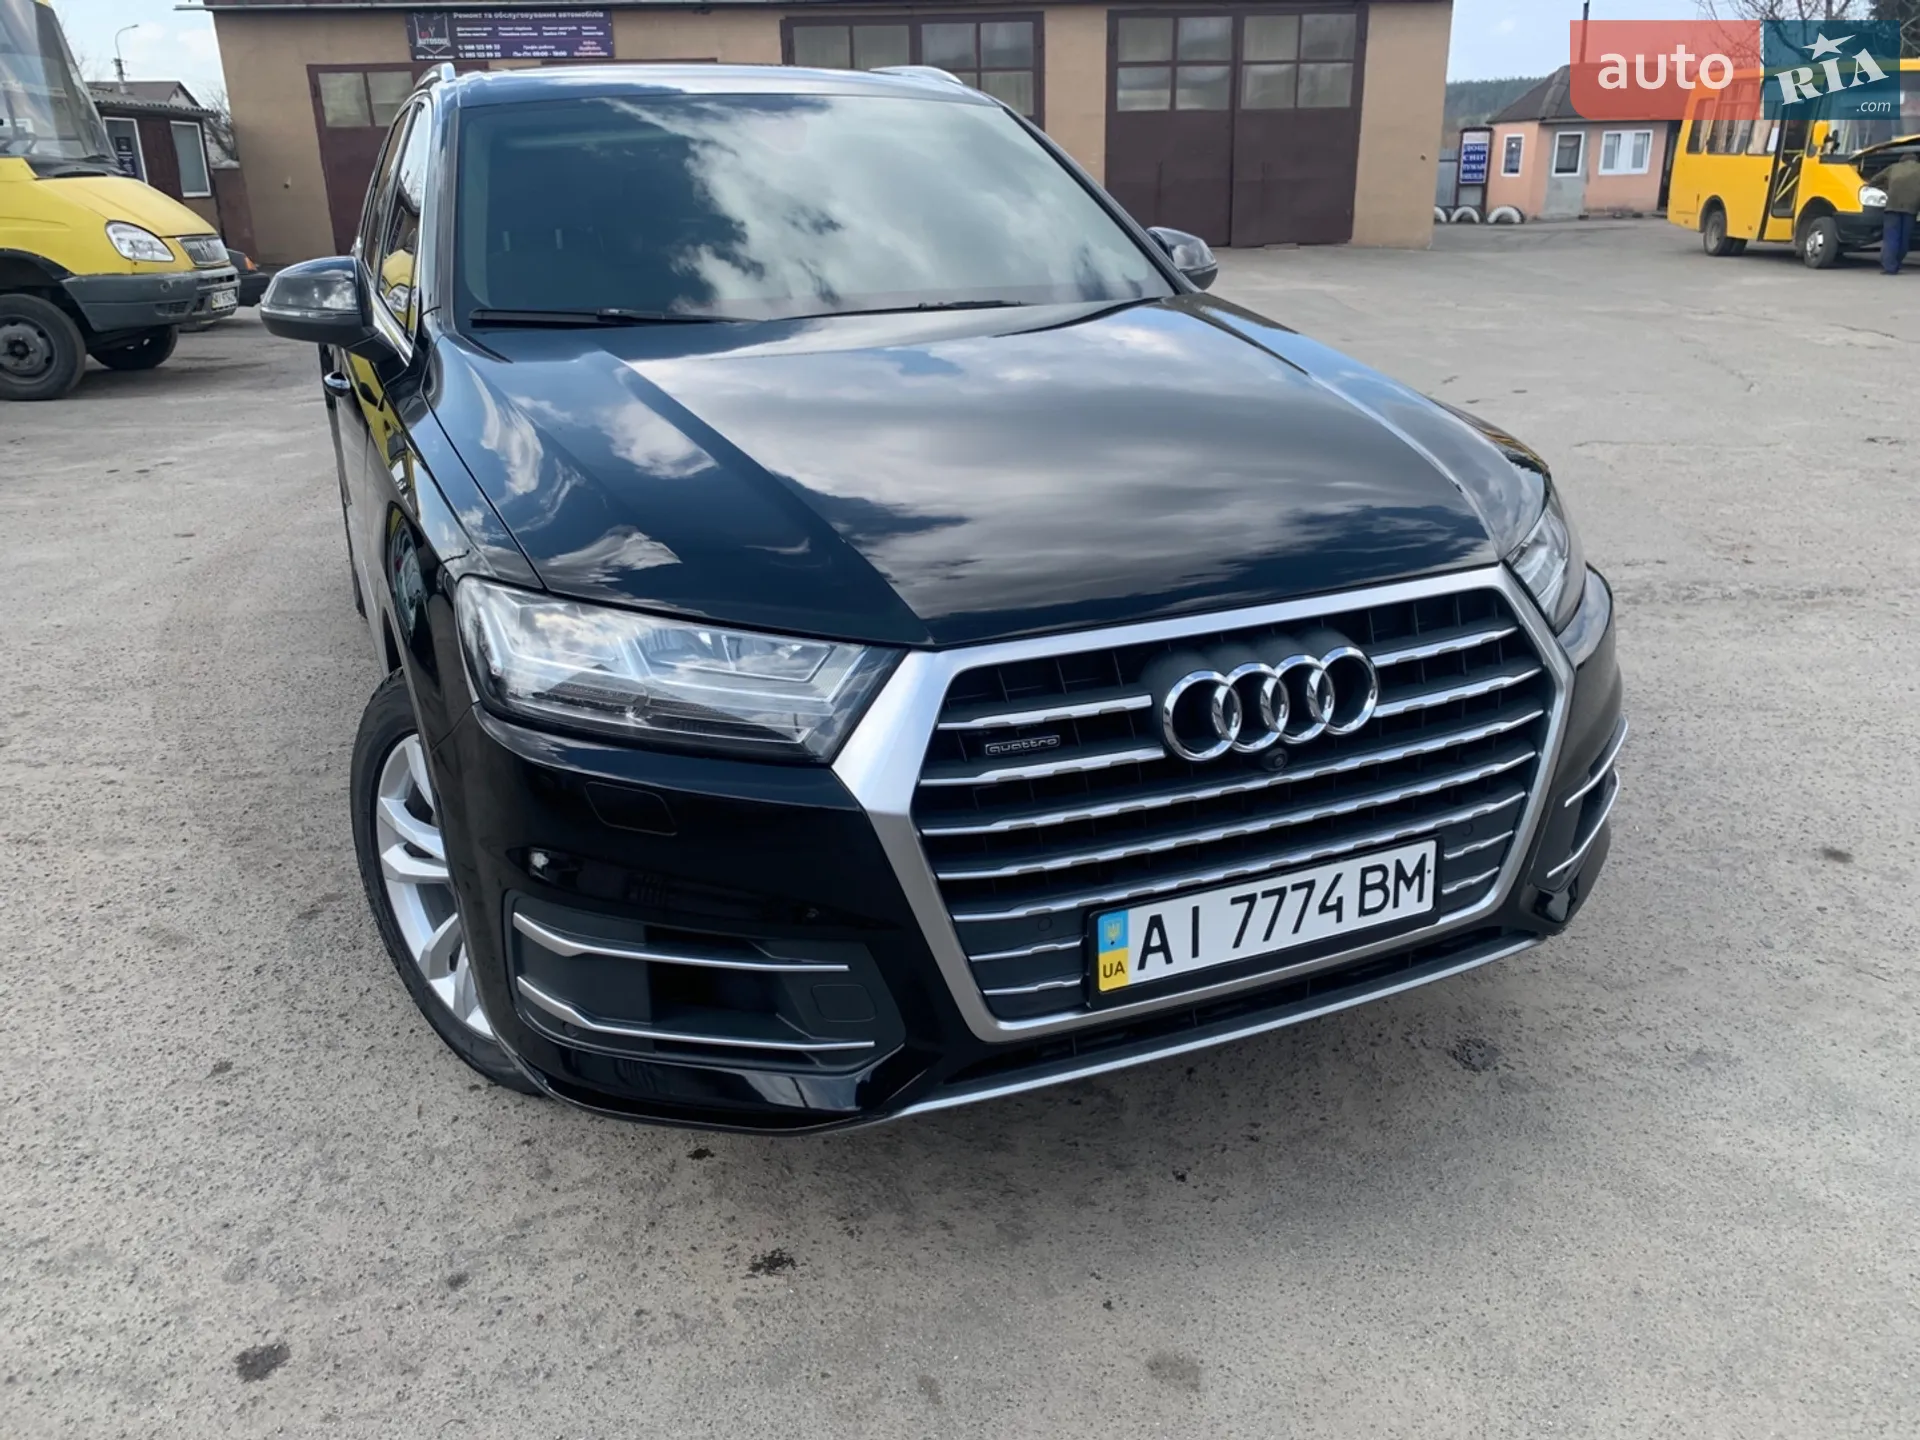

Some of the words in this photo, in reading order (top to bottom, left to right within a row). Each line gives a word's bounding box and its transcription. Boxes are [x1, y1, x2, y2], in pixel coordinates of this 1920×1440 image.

[453, 11, 482, 19] Ремонт
[494, 11, 557, 20] обслуговування
[558, 10, 605, 19] автомобілів
[989, 738, 1058, 753] quattro
[1137, 905, 1200, 971] AI
[1230, 872, 1344, 949] 7774
[1358, 852, 1427, 918] BM
[1103, 963, 1126, 978] UA
